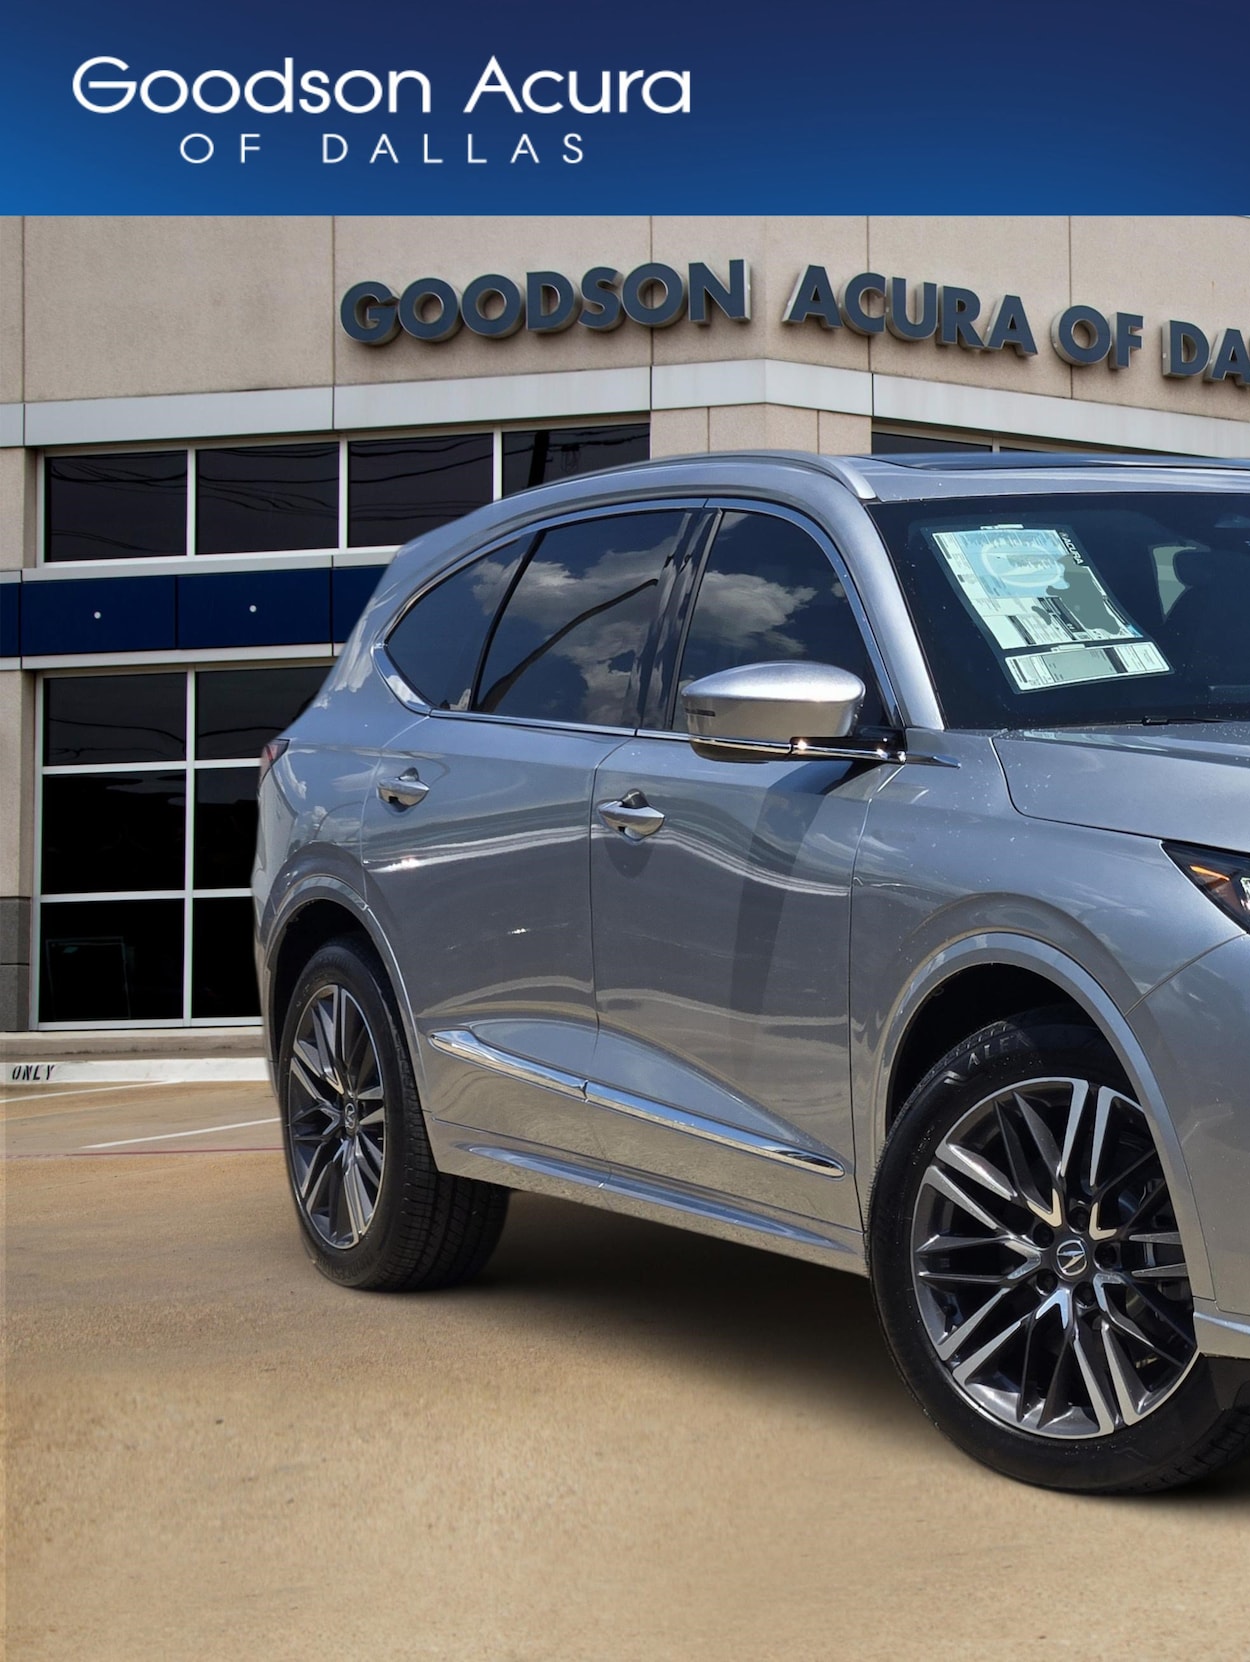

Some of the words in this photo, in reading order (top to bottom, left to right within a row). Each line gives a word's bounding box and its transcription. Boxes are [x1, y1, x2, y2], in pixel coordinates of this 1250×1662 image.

[340, 259, 751, 347] GOODSON
[782, 264, 1038, 356] ACURA
[1050, 304, 1144, 370] OF
[1062, 537, 1084, 565] ACURA
[12, 1064, 56, 1081] ONLY
